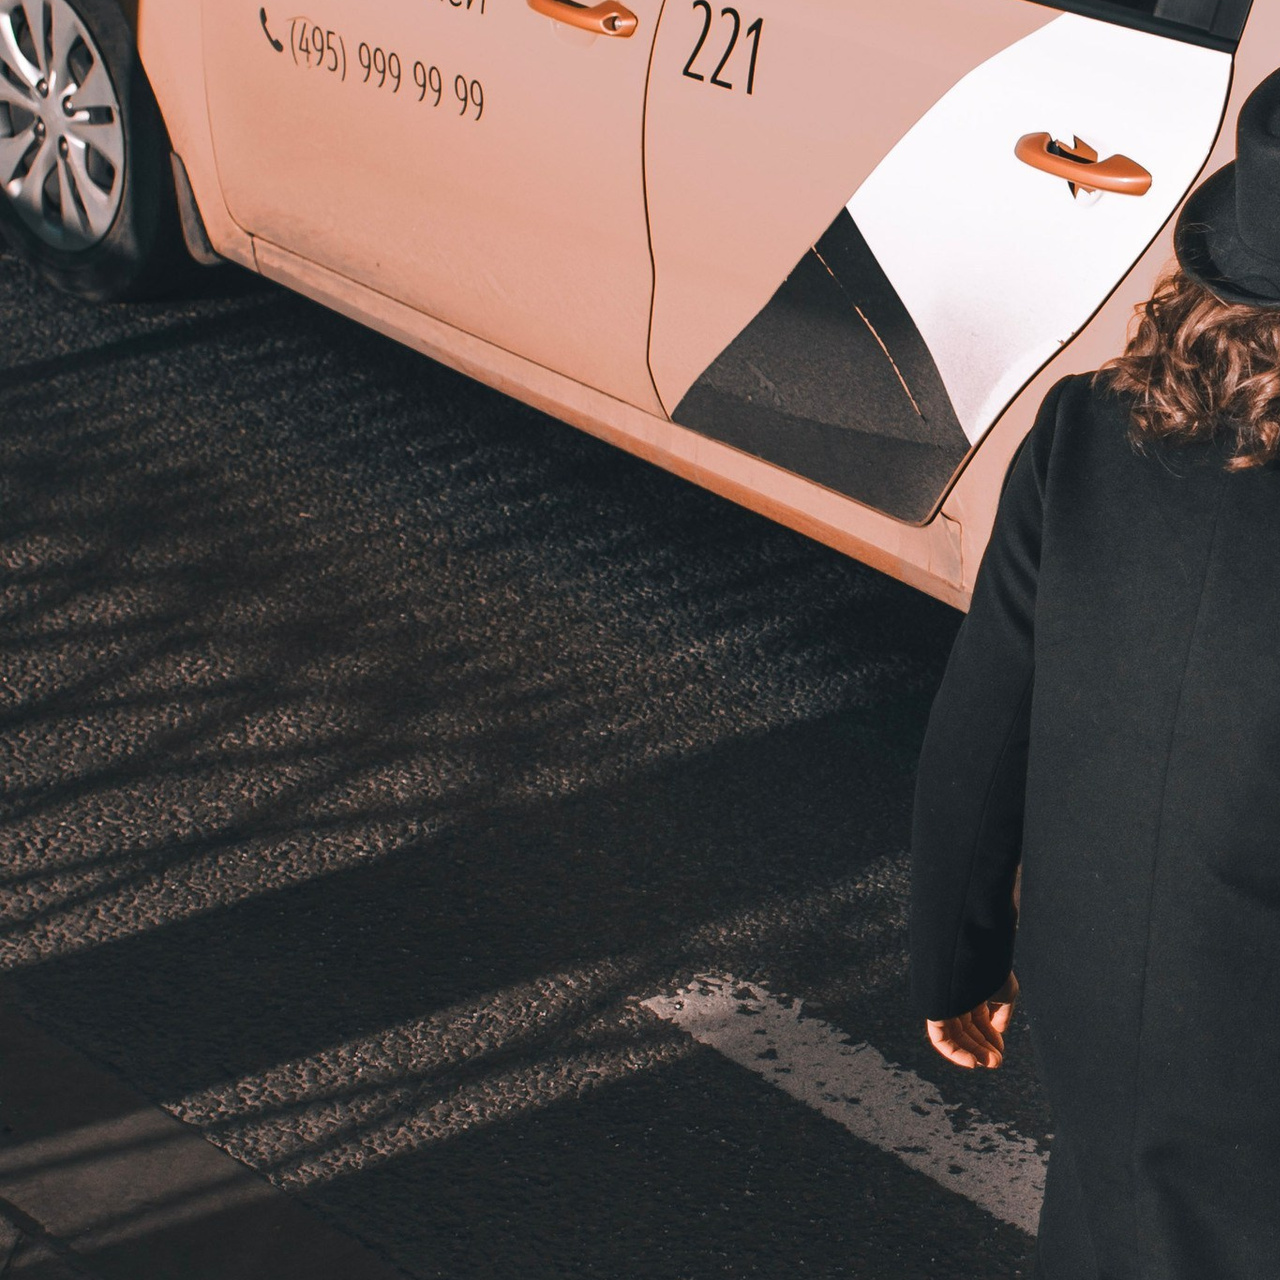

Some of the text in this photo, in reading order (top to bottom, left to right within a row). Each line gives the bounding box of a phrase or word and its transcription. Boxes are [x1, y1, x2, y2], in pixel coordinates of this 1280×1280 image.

[289, 17, 485, 121] (495) 999 99 99
